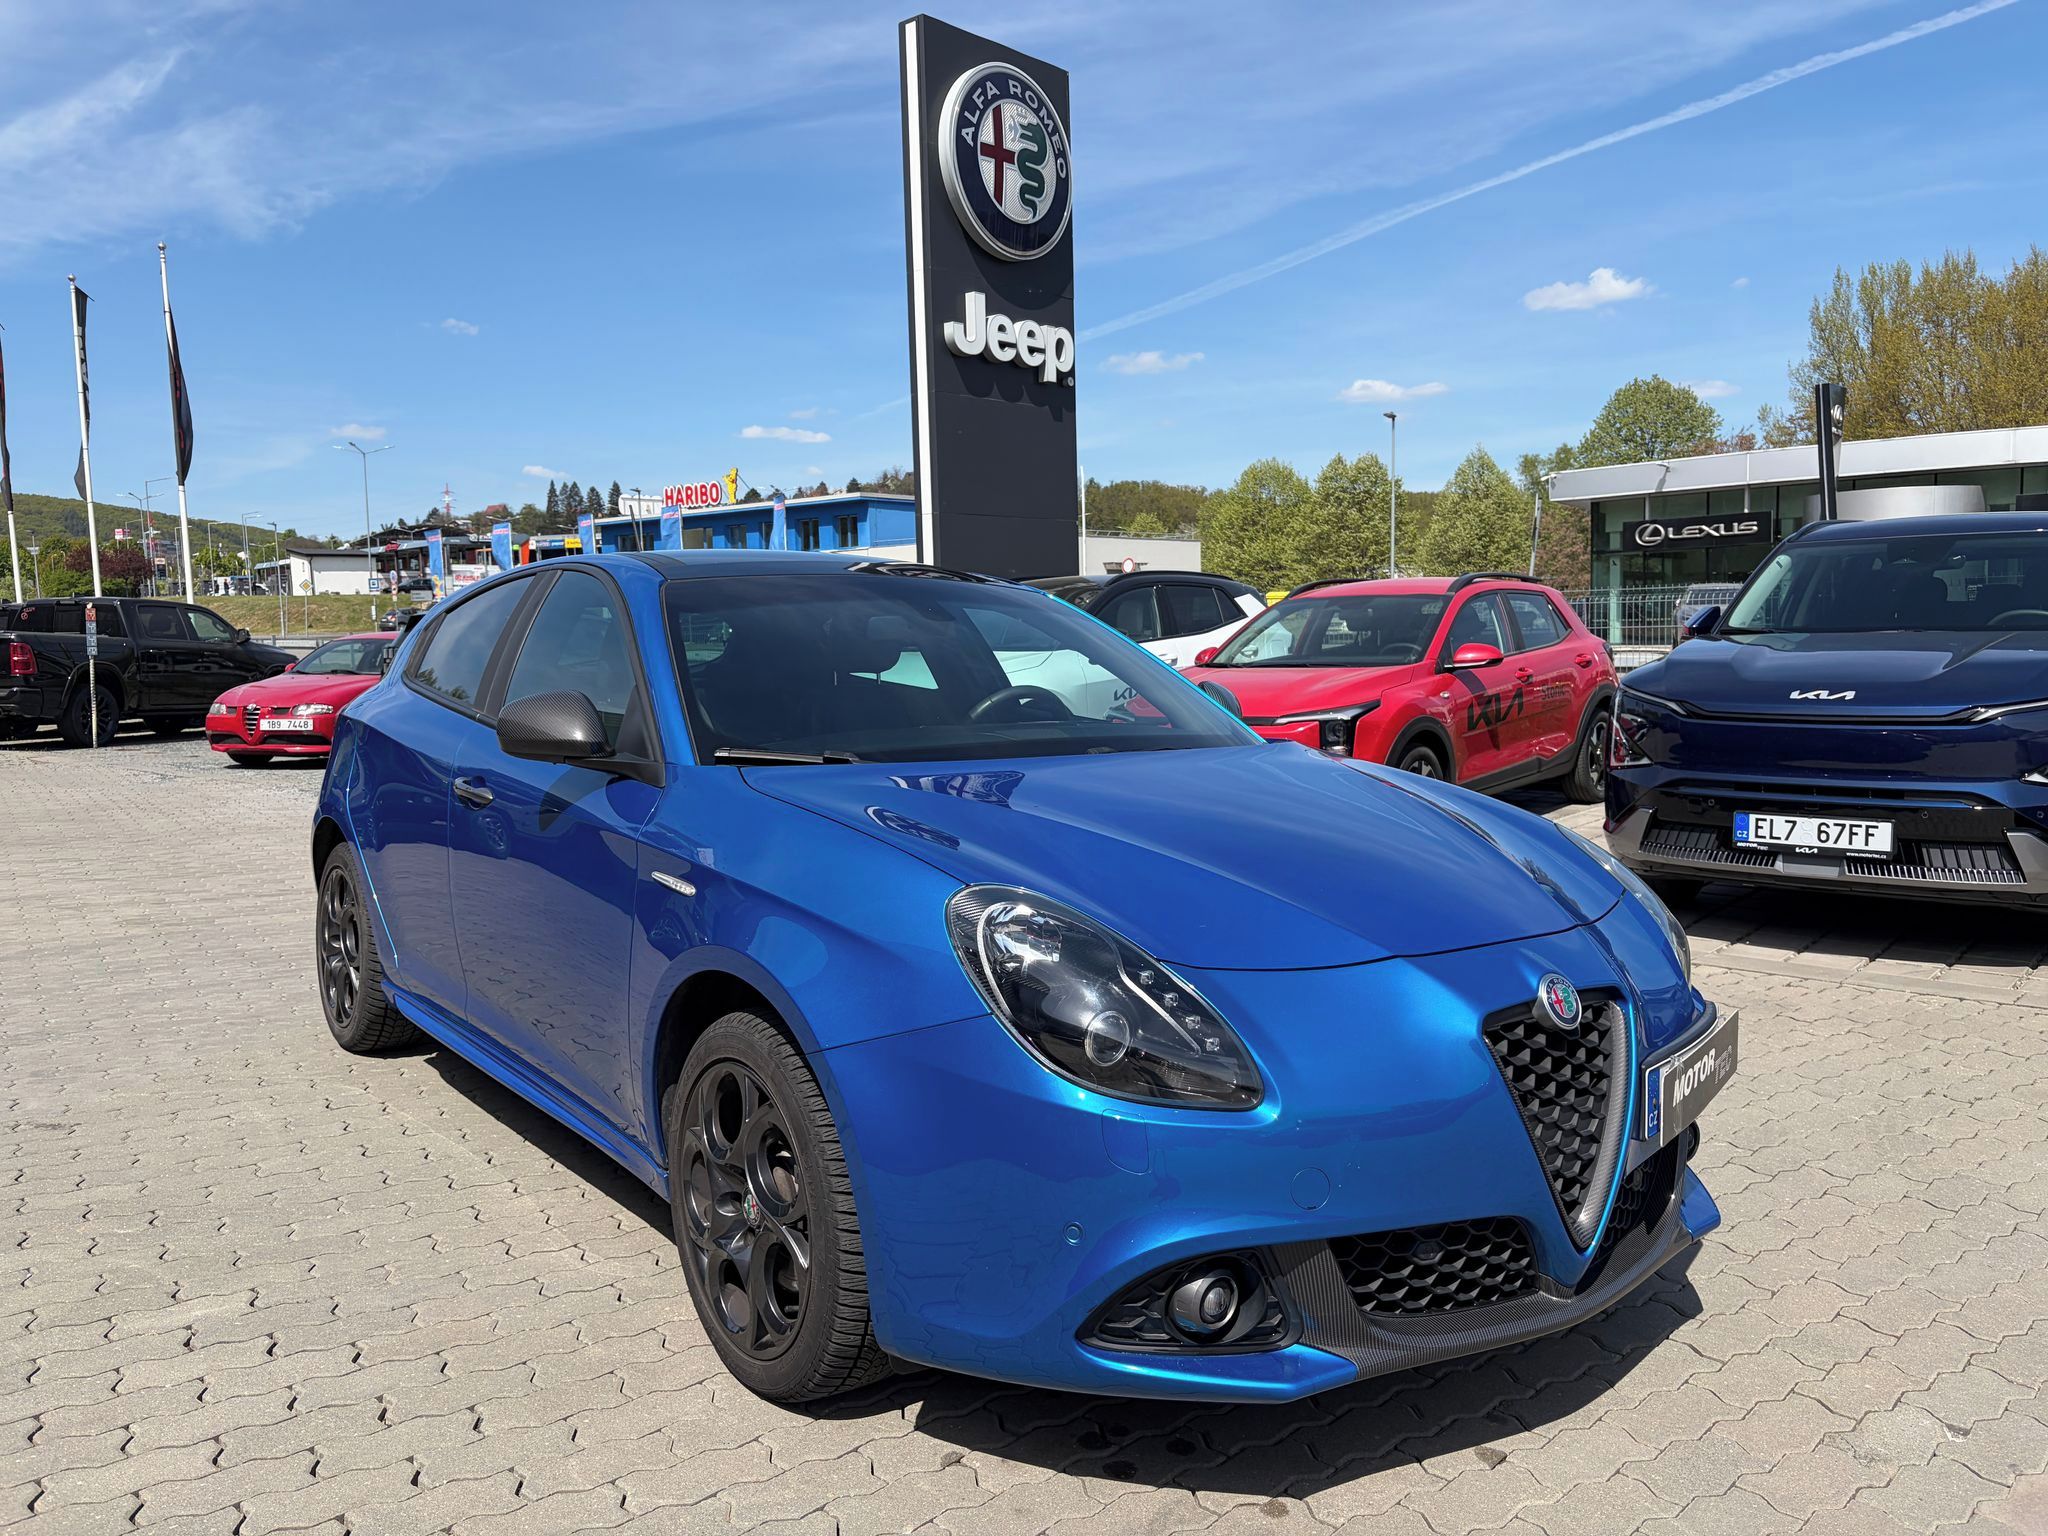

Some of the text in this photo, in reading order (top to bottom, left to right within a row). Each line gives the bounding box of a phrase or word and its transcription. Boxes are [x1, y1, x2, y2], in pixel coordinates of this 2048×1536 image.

[961, 79, 1066, 179] ALFA ROMEO
[944, 291, 1074, 383] Jeep
[664, 482, 720, 507] HARIBO
[1667, 521, 1758, 539] LEXUS
[1542, 685, 1566, 701] Stonic
[1790, 690, 1856, 702] KIA
[1468, 687, 1524, 731] KIA
[267, 720, 309, 729] 1B9 7448
[1737, 830, 1748, 838] CZ
[1755, 818, 1879, 846] EL7 67FF
[1672, 1047, 1715, 1107] MOTOR
[1648, 1108, 1659, 1128] CZ
